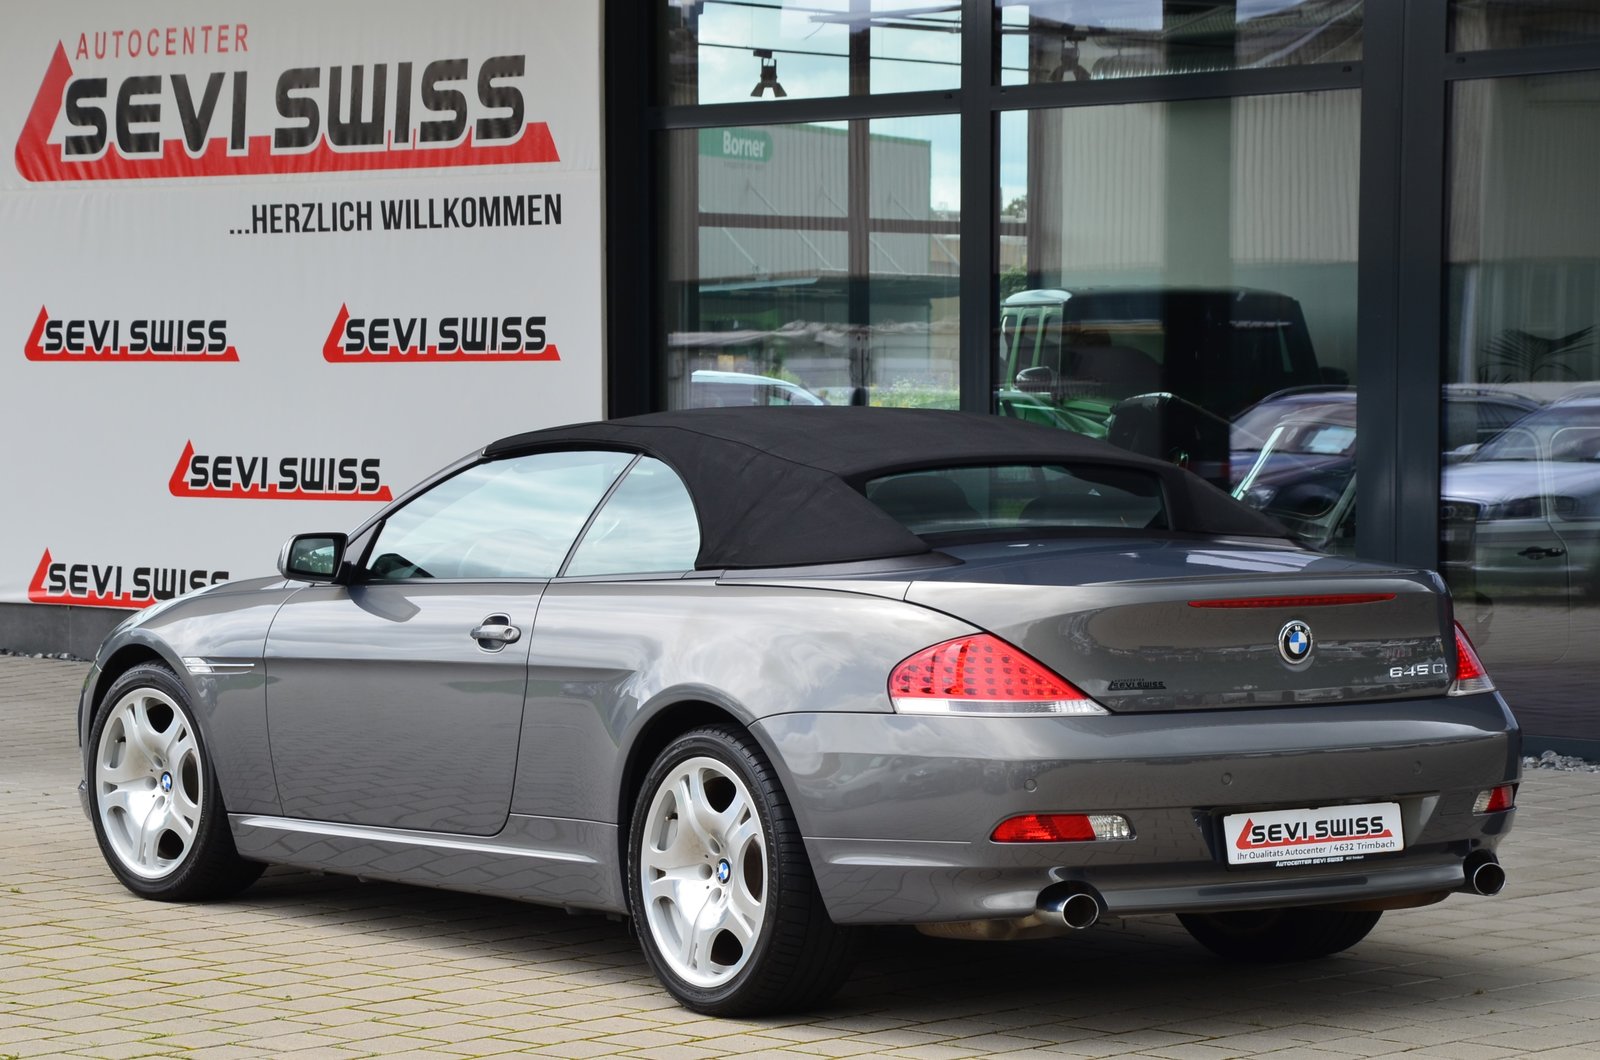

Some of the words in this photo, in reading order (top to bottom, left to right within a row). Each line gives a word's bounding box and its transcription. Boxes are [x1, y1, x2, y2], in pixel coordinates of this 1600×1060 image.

[76, 23, 250, 60] AUTOCENTER
[64, 71, 248, 156] SEVI
[274, 54, 526, 150] SWISS
[380, 193, 563, 230] WILLKOMMEN
[44, 319, 119, 352] SEVI
[129, 319, 227, 353] SWISS
[345, 317, 427, 352] SEVI
[437, 316, 547, 352] SWISS
[190, 455, 267, 489] SEVI
[278, 456, 381, 492] SWISS
[49, 563, 123, 599] SEVI
[132, 567, 230, 601] SWIS
[1390, 664, 1429, 678] 645
[1252, 821, 1308, 843] SEVI
[1315, 816, 1383, 838] SWISS
[1237, 852, 1248, 860] Ihr
[1285, 846, 1327, 856] Autocenter
[1357, 840, 1395, 850] Trimbach
